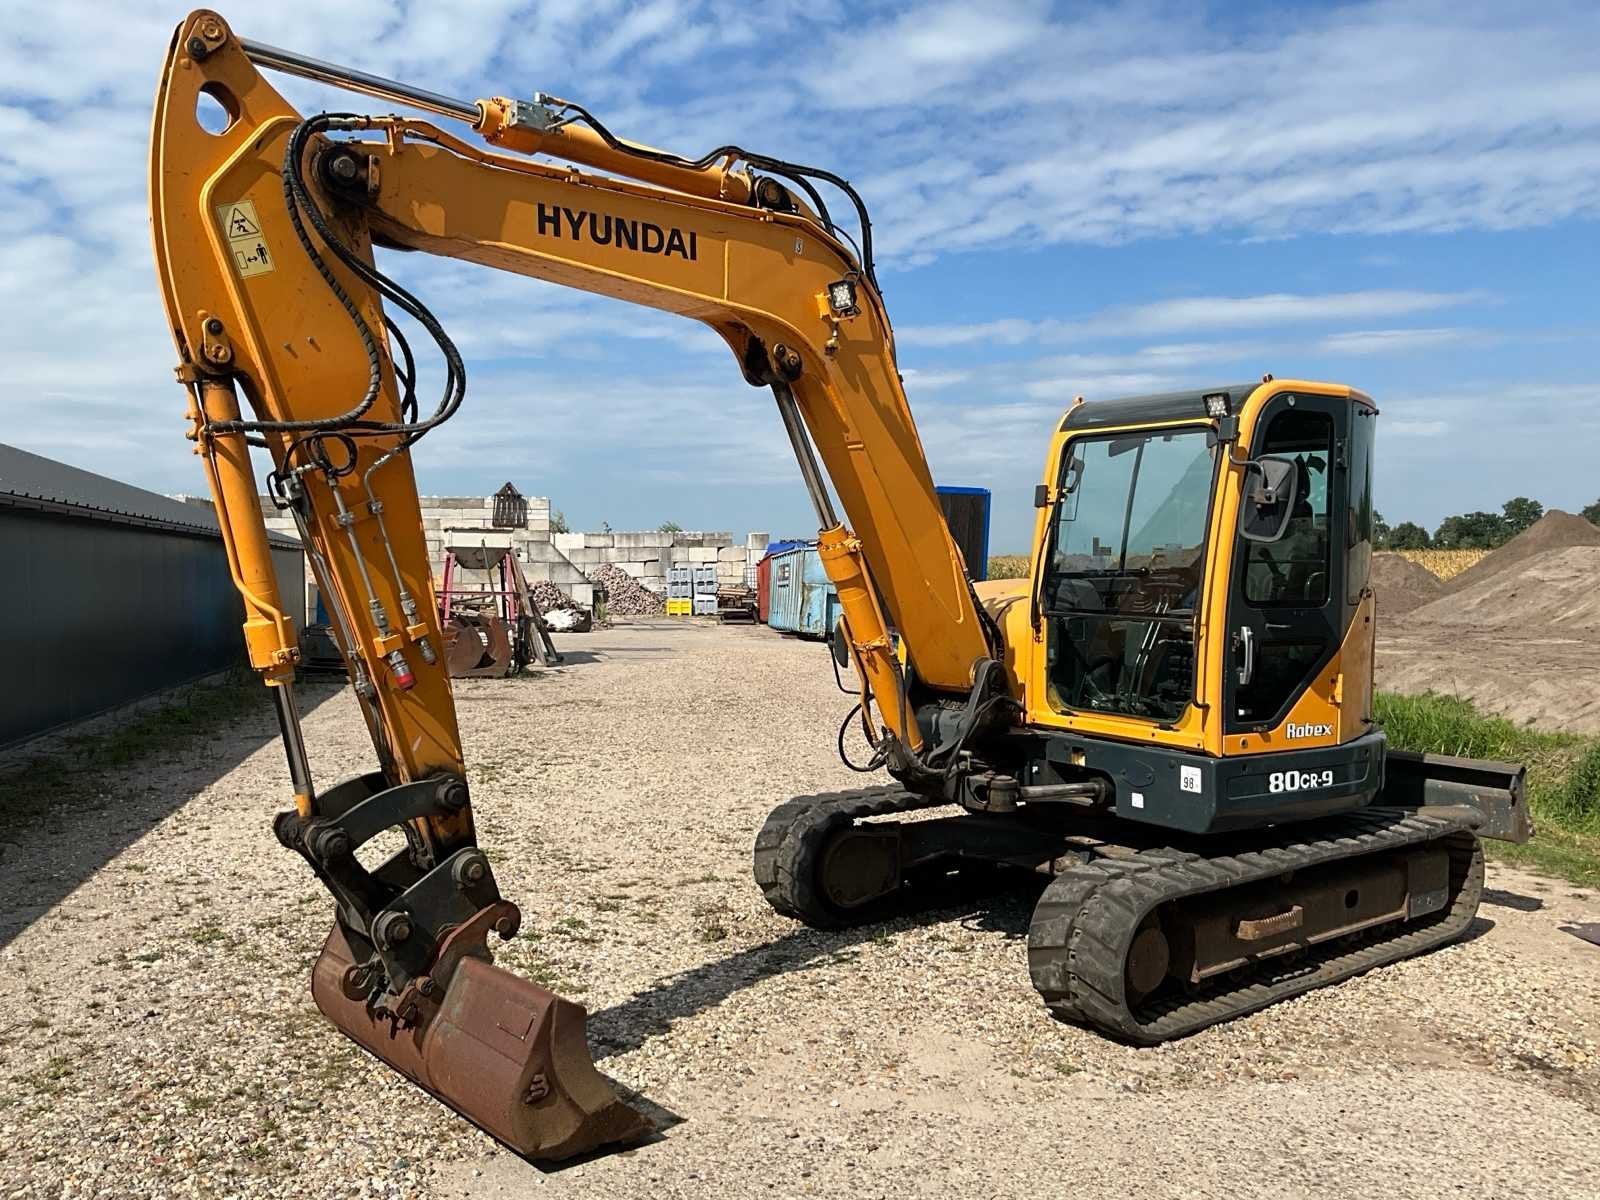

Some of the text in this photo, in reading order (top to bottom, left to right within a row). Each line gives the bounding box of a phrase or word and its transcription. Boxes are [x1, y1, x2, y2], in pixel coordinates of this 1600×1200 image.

[537, 203, 697, 261] HYUNDAI
[1286, 722, 1332, 739] Robex
[1183, 776, 1194, 789] 98
